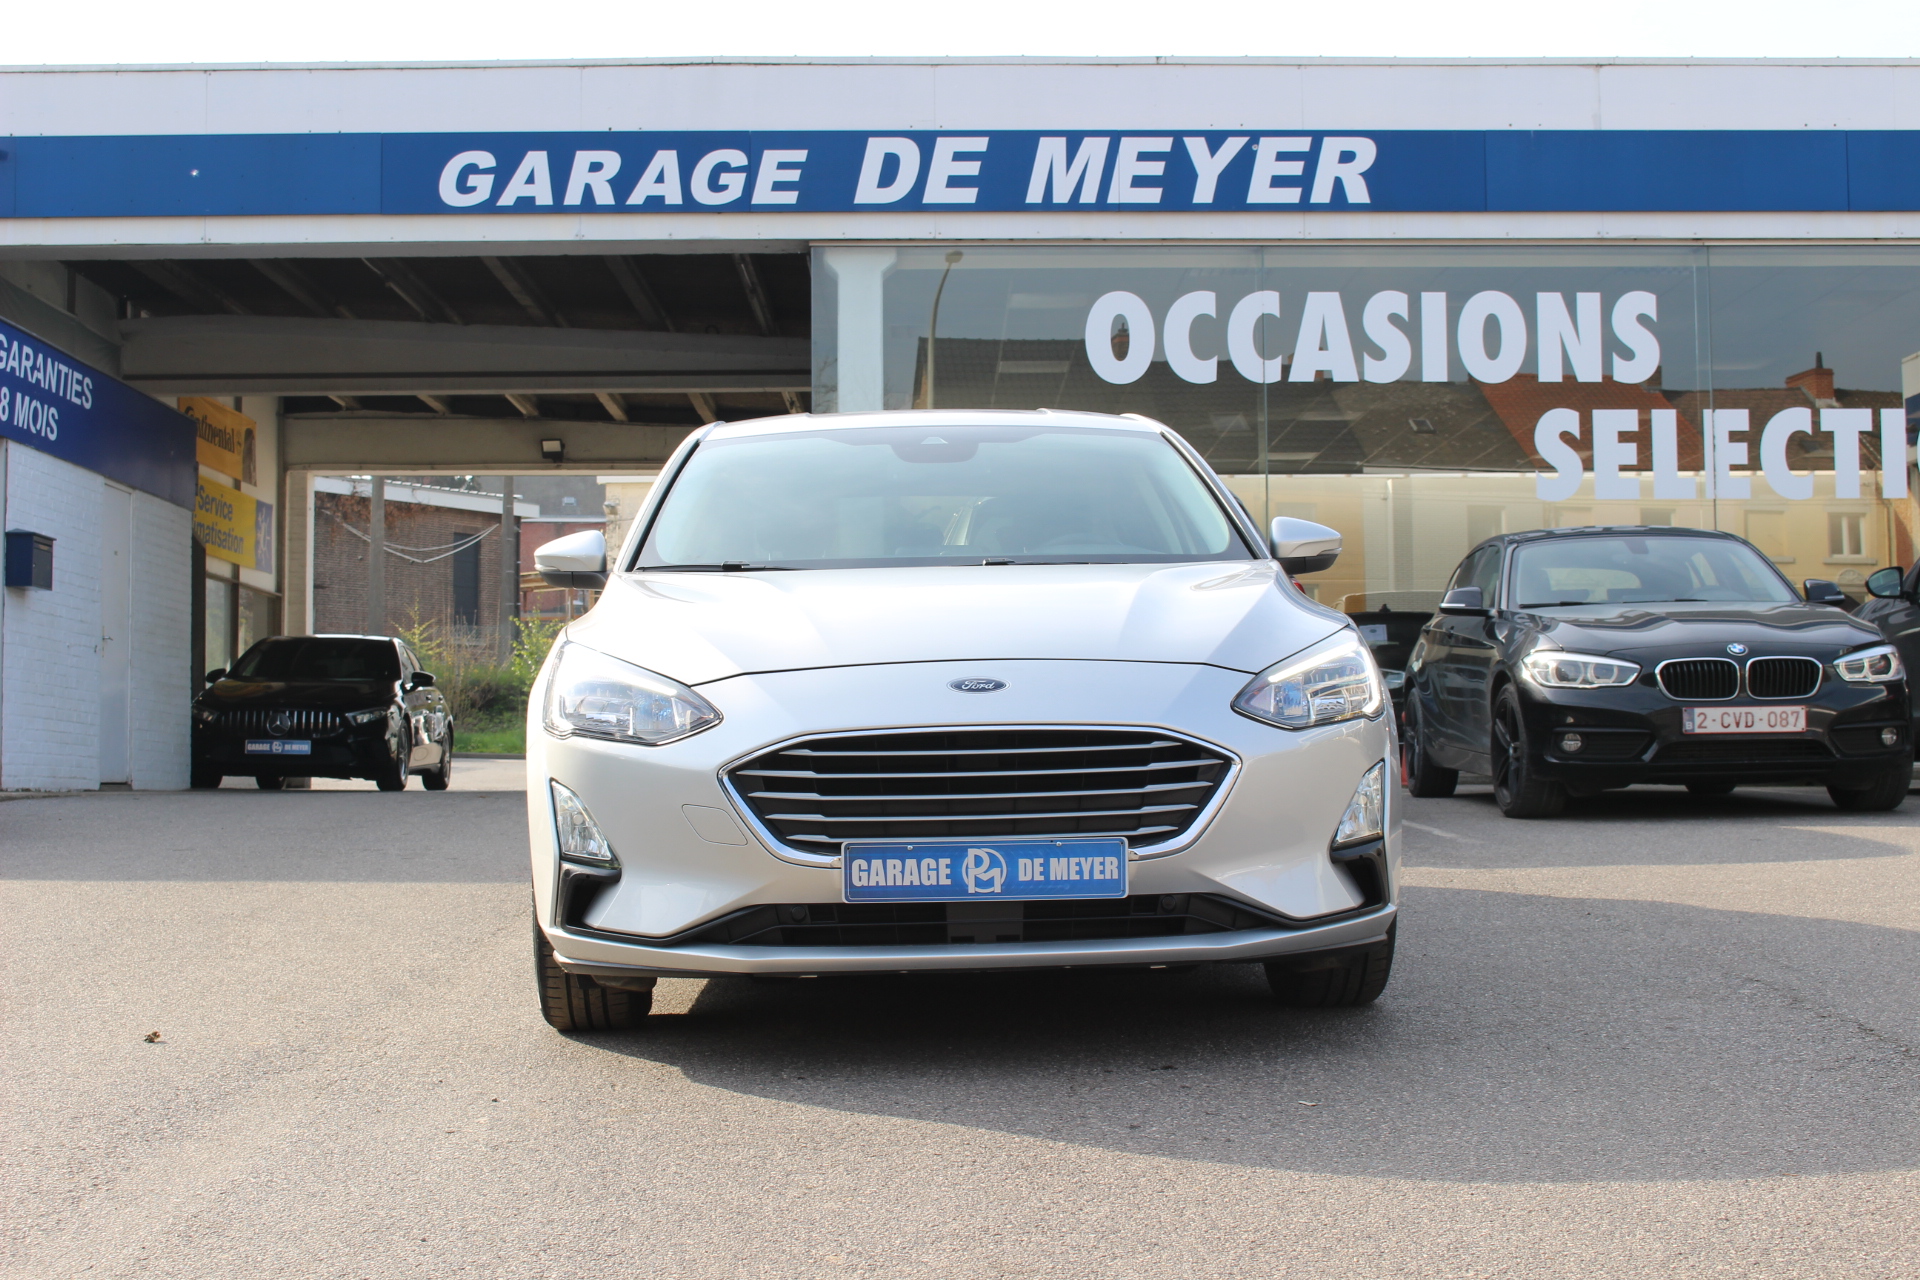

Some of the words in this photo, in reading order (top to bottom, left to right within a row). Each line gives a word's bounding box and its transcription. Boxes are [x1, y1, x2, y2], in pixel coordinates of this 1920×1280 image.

[438, 149, 809, 208] GARAGE
[853, 136, 990, 205] DE
[1025, 136, 1378, 204] MEYER
[1085, 290, 1661, 385] OCCASIONS
[13, 391, 59, 441] MOIS
[1534, 407, 1920, 501] SELECTI
[198, 485, 234, 522] Service
[961, 680, 997, 690] Ford
[1685, 721, 1693, 731] B
[1696, 710, 1801, 730] 2-CVD-087
[851, 857, 952, 887] GARAGE
[1018, 858, 1045, 882] DE
[1049, 856, 1119, 881] MEYER
